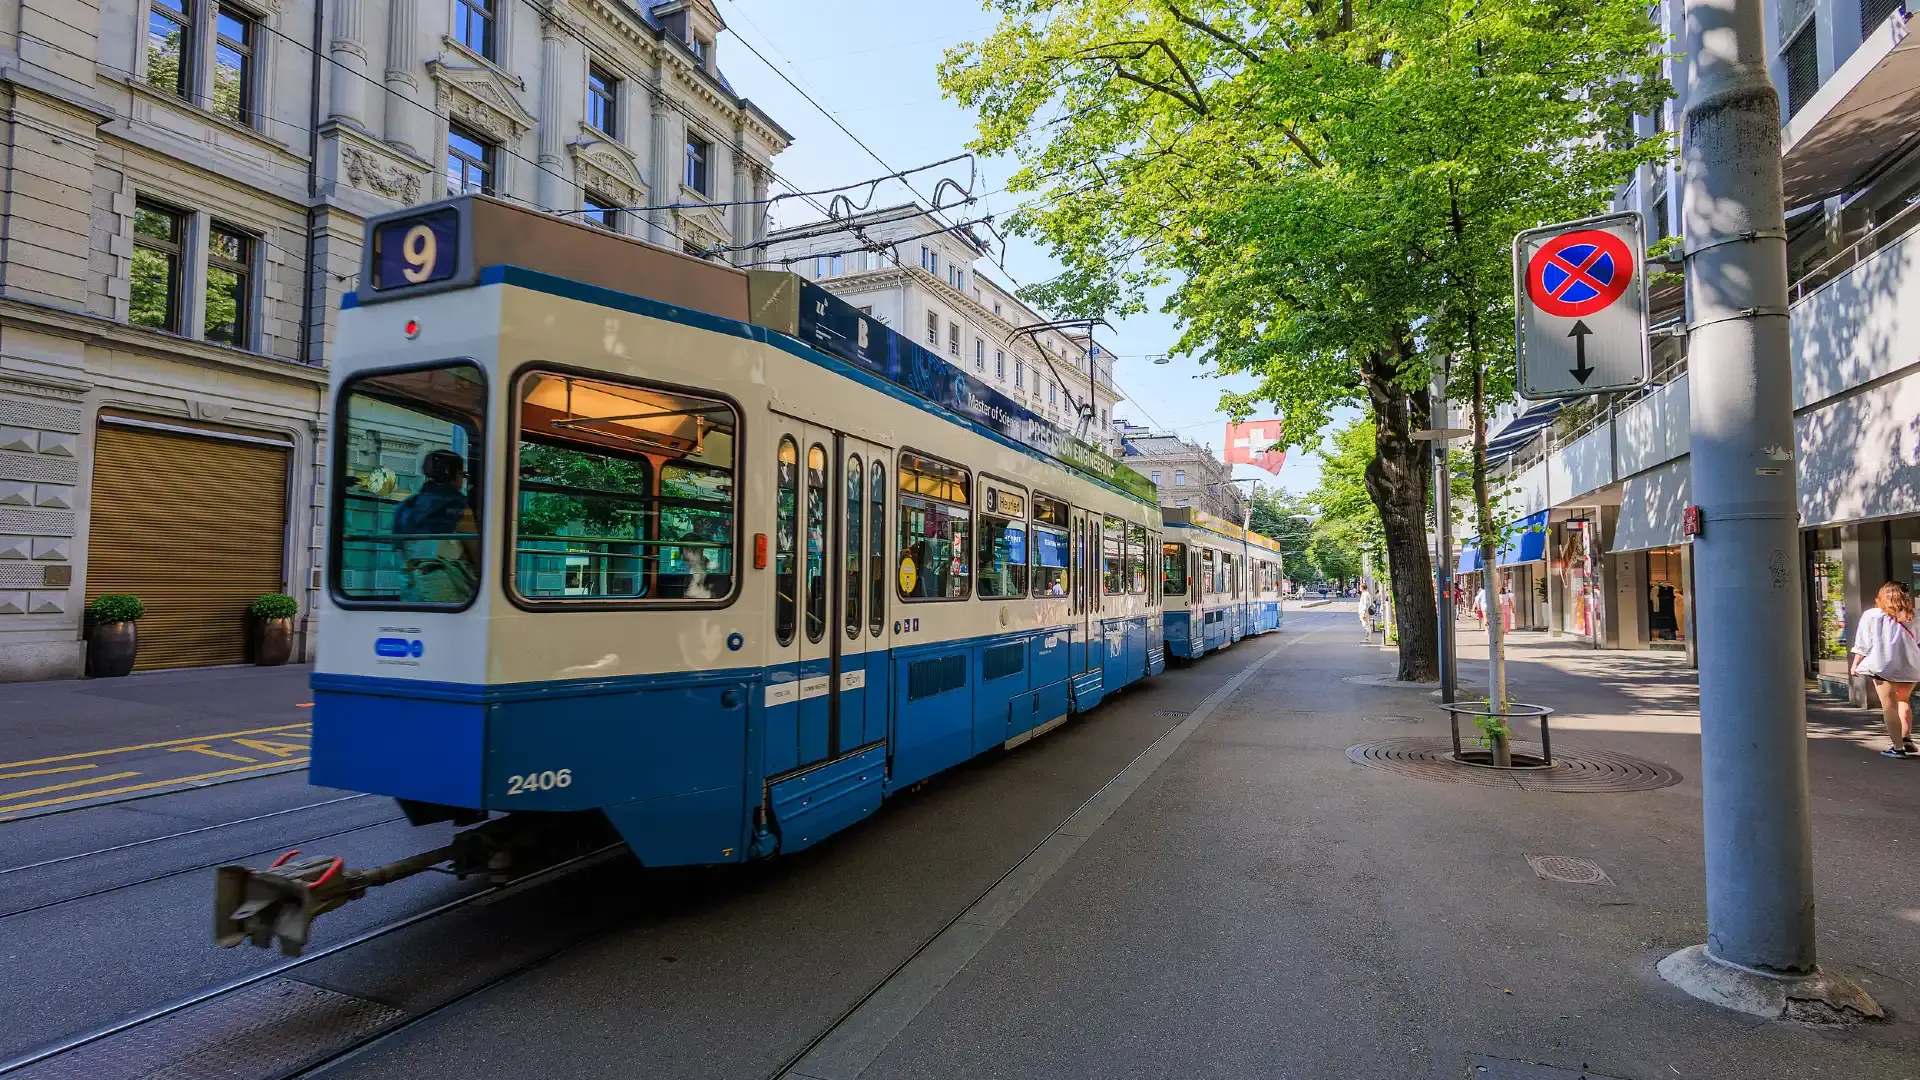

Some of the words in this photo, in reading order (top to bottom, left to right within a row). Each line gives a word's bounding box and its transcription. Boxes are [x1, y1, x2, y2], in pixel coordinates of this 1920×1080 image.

[402, 225, 437, 283] 9
[968, 392, 991, 416] Master
[991, 404, 998, 420] of
[999, 408, 1020, 430] Science
[1028, 418, 1073, 457] PRECISION
[1074, 443, 1115, 478] ENGINEERING
[987, 491, 994, 509] 9
[507, 768, 572, 795] 2406
